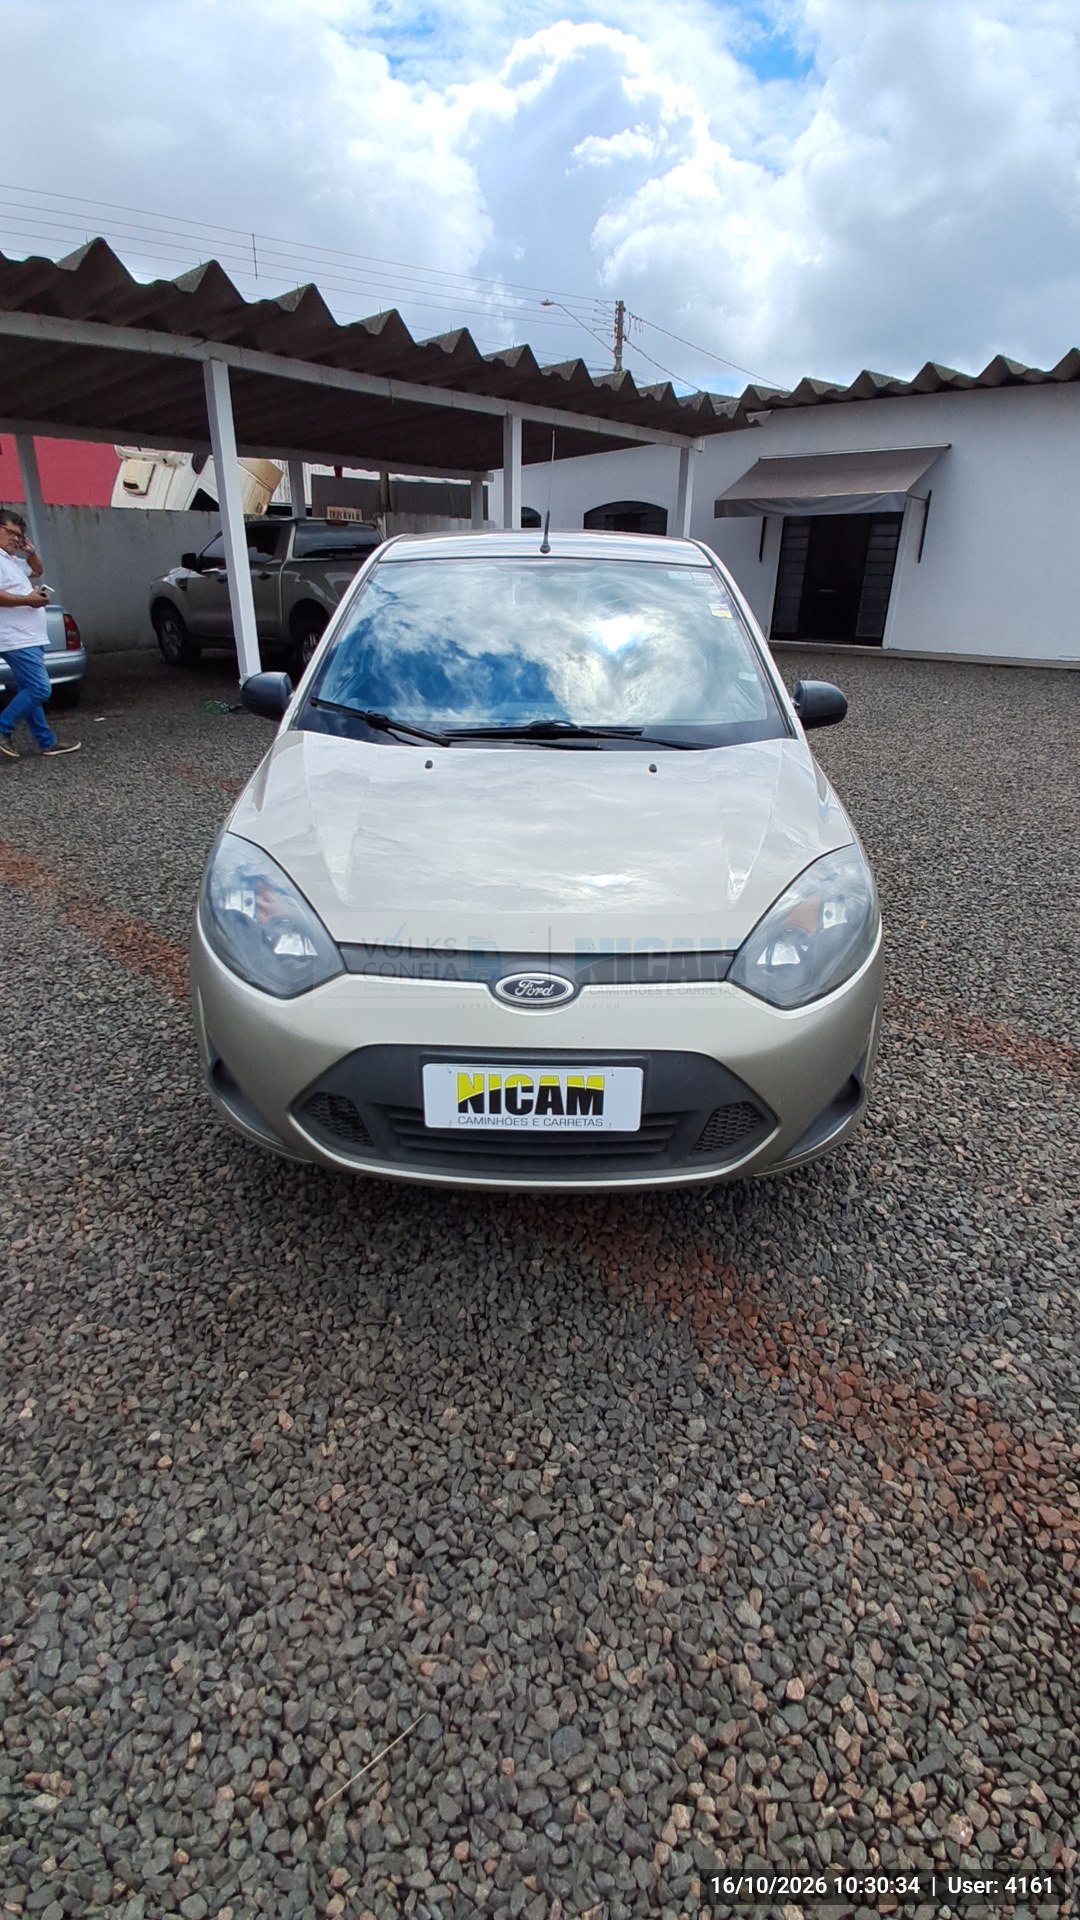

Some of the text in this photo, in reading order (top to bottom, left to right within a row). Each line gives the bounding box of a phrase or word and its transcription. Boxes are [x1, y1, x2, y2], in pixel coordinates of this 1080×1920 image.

[514, 979, 555, 996] Ford
[457, 1072, 605, 1116] NICAM
[458, 1115, 603, 1127] CAMINHÕES E CARRETAS
